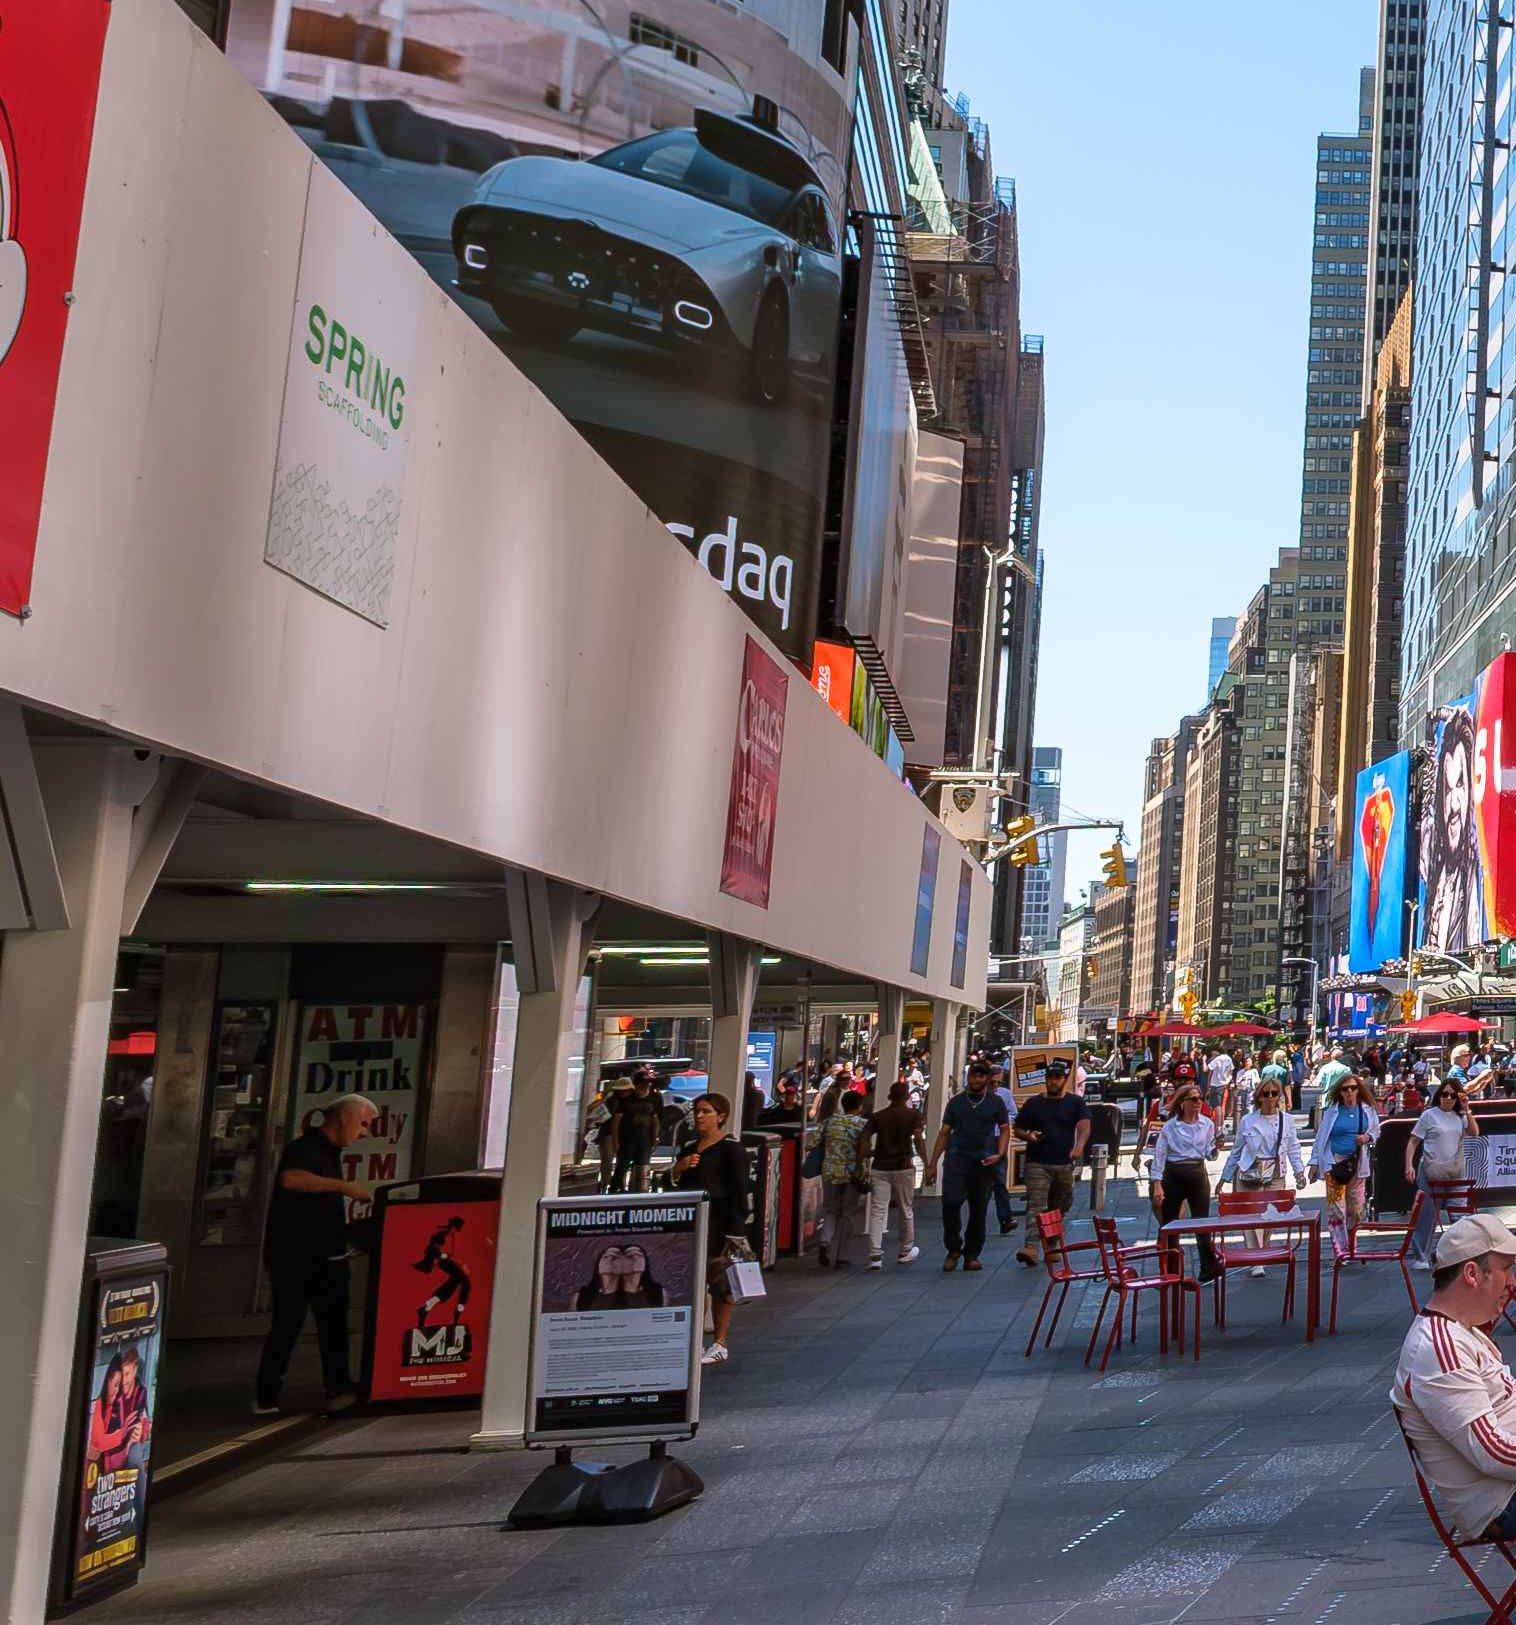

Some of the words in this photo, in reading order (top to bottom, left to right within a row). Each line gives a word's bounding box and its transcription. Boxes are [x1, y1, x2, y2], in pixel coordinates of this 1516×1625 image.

[305, 303, 405, 431] SPRING
[318, 380, 389, 451] SCAFFOLDING
[665, 516, 793, 631] daq
[308, 1006, 416, 1042] ATM
[305, 1058, 413, 1094] Drink
[342, 1153, 397, 1182] TM
[551, 1210, 626, 1228] MIDNIGHT
[628, 1207, 696, 1224] MOMENT
[411, 1324, 466, 1357] MJ
[91, 1482, 138, 1515] strangers
